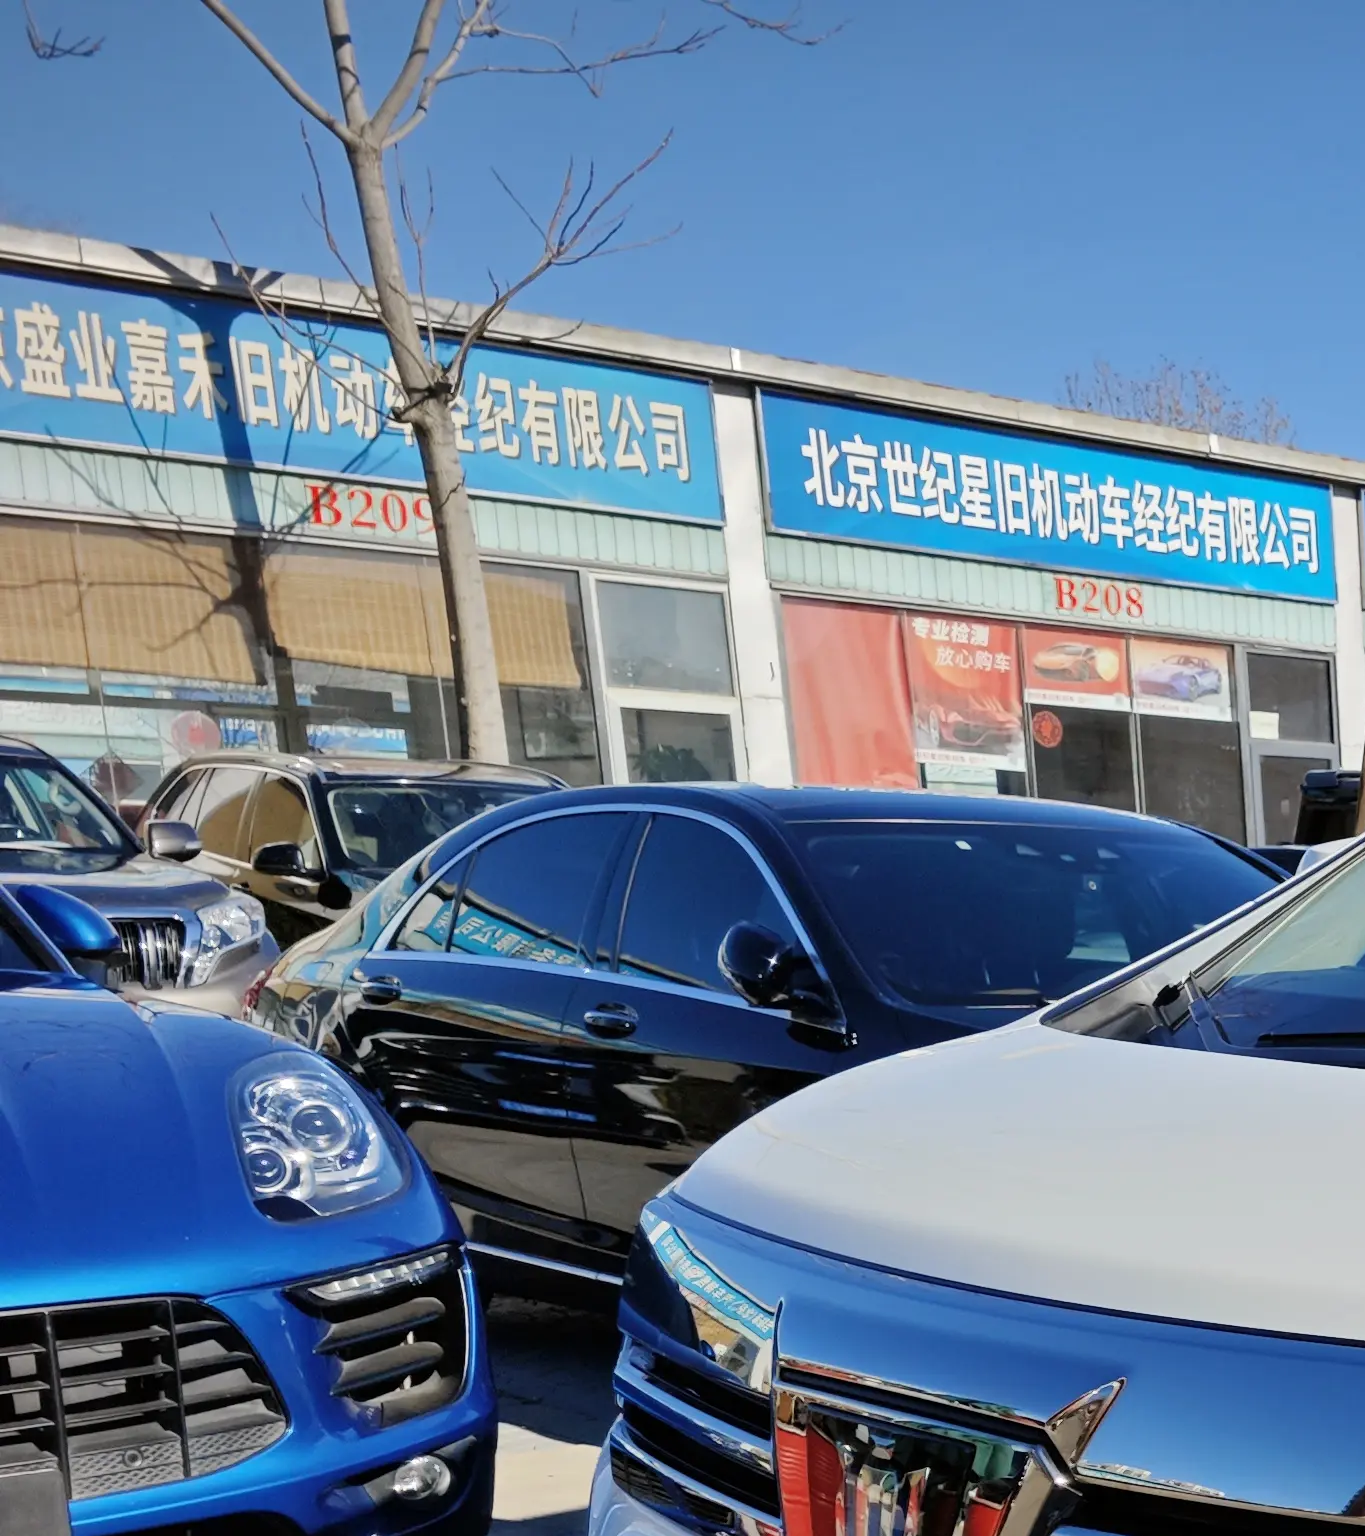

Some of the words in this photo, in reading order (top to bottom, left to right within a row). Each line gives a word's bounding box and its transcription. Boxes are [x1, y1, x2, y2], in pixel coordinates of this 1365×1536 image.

[801, 428, 1320, 574] 北京世纪星旧机动车经纪有限公司
[1054, 577, 1145, 618] B208
[911, 617, 990, 648] 专业检测
[935, 648, 1012, 674] 放心购车
